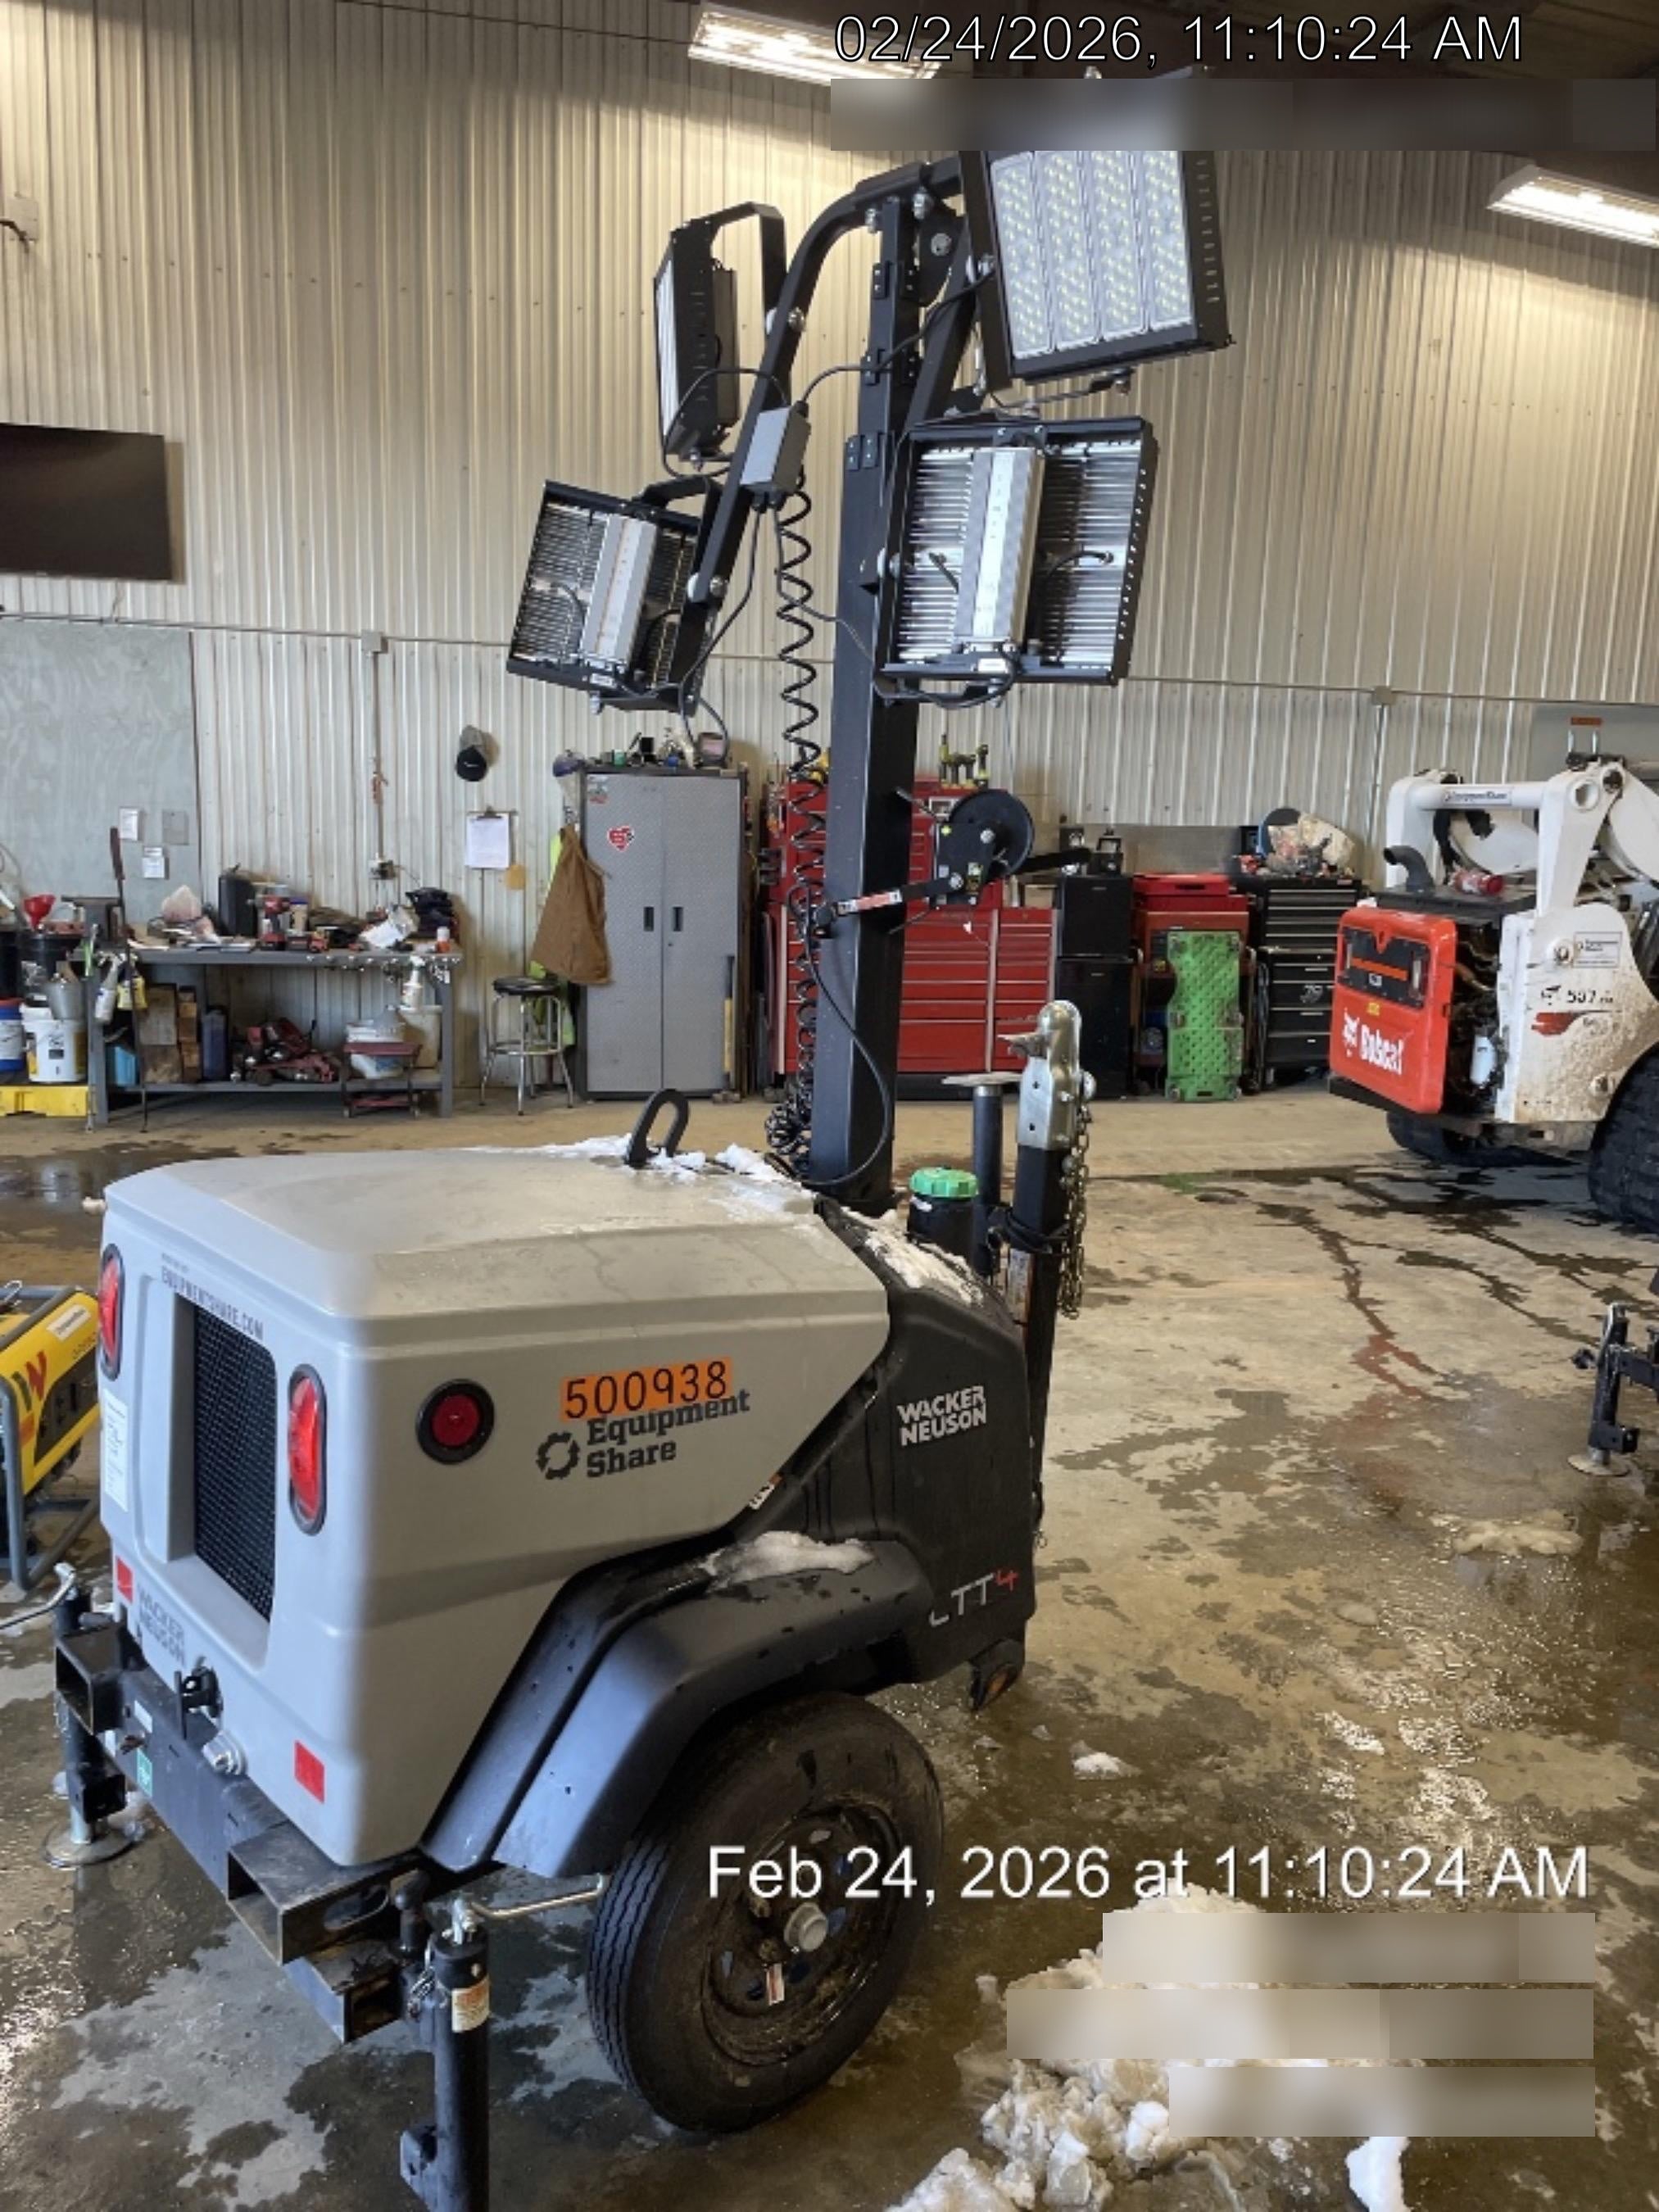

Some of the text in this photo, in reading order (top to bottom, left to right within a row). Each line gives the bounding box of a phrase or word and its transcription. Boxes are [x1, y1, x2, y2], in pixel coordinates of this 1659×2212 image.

[564, 1360, 728, 1419] 500938
[897, 1385, 986, 1424] WACKER
[586, 1388, 751, 1447] Equipment
[900, 1400, 986, 1446] NEUSON
[586, 1439, 678, 1478] Share
